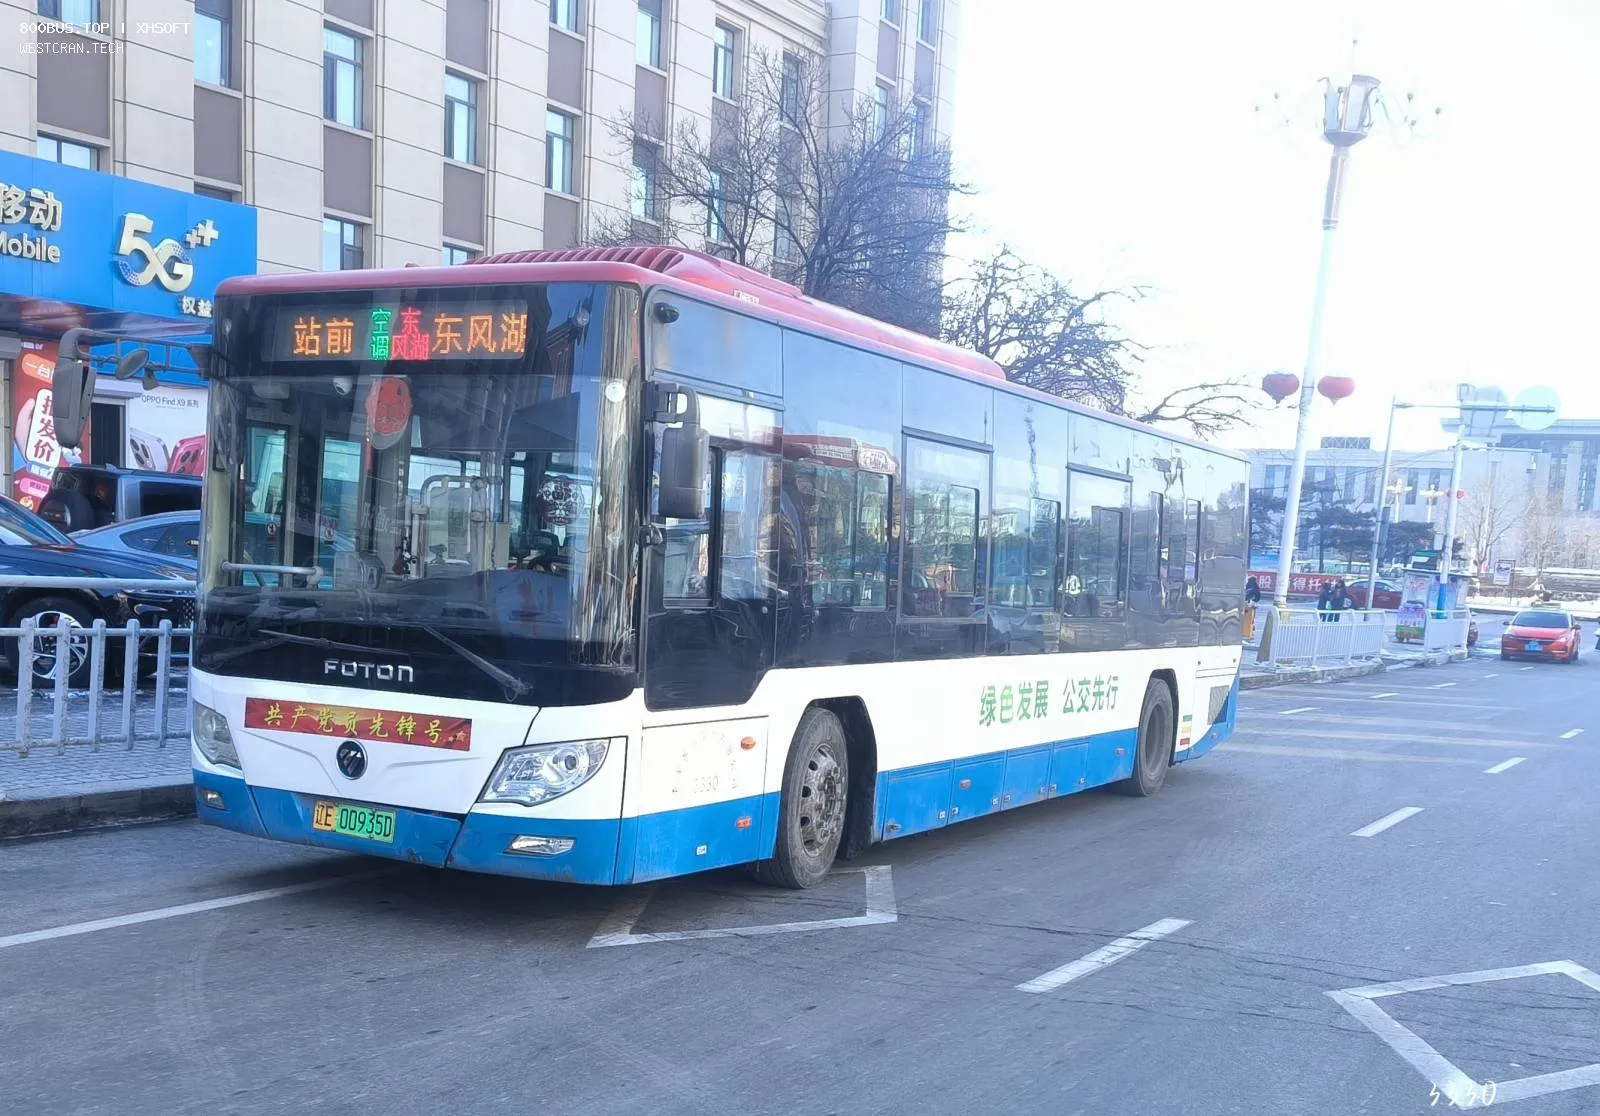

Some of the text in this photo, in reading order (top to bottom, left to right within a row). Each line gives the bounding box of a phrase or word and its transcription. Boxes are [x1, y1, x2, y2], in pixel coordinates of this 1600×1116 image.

[293, 312, 528, 356] 站前 东风湖
[141, 395, 161, 405] OPPO
[324, 659, 414, 683] FOTON
[979, 674, 1119, 727] 绿色发展 公交先行
[263, 703, 444, 745] 共产党员先锋号
